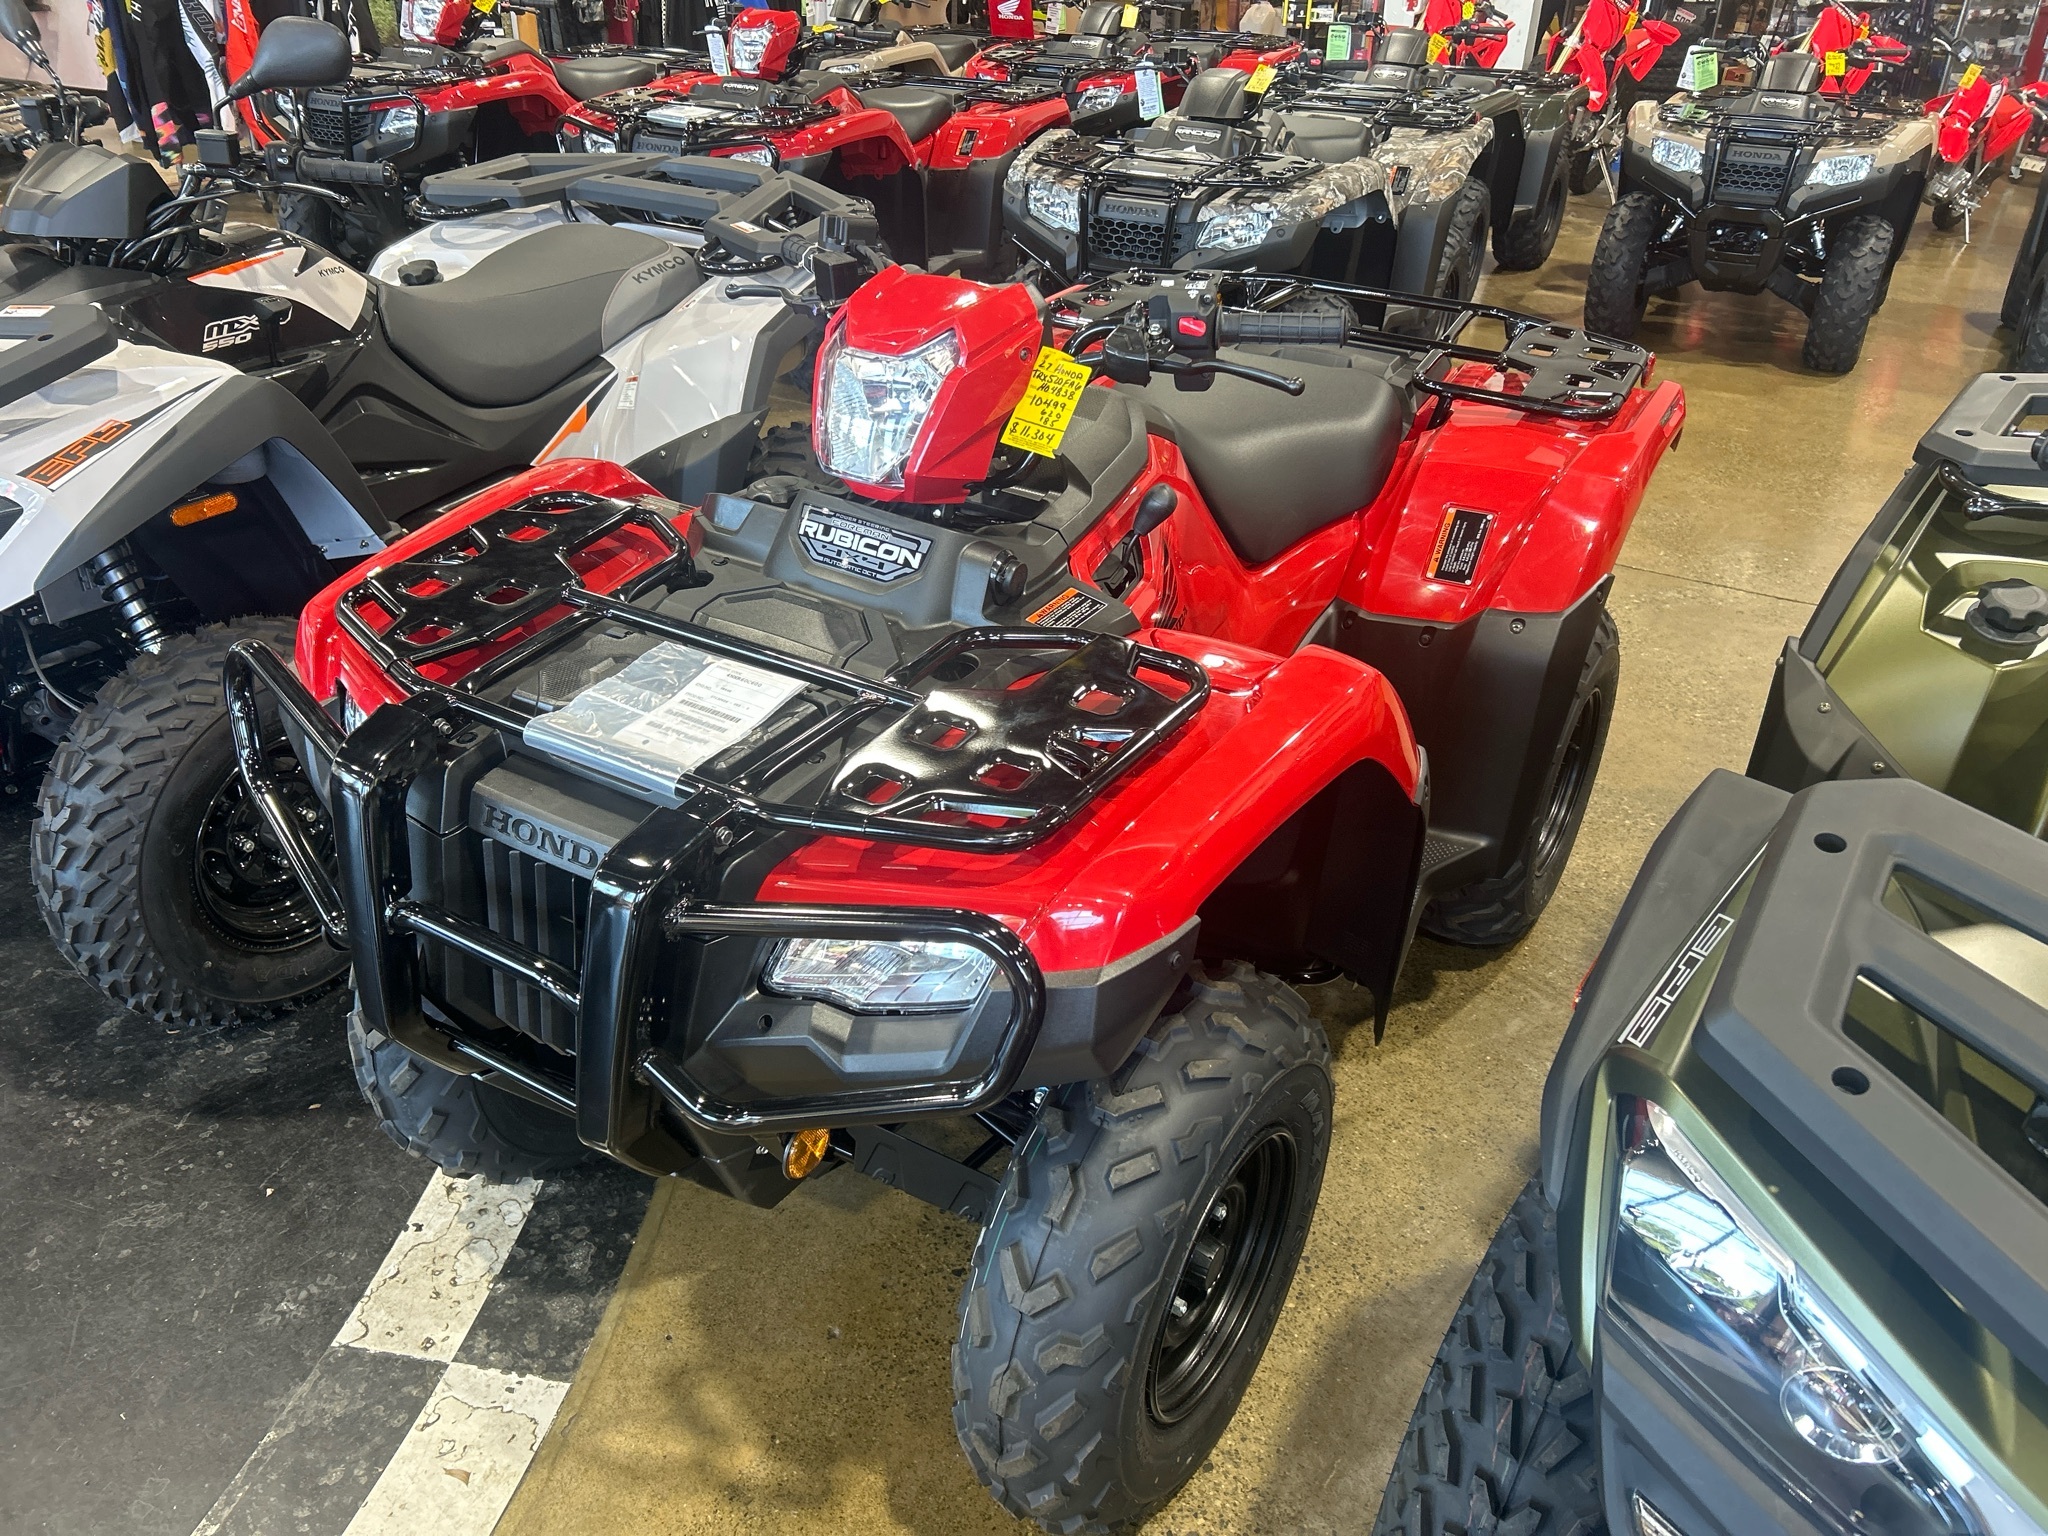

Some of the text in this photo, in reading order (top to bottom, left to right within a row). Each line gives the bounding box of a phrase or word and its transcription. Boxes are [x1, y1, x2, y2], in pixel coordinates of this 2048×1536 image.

[722, 83, 759, 93] FOREMAN
[1175, 129, 1221, 139] RANCHER
[636, 141, 679, 154] HONDA
[1732, 150, 1782, 161] HONDA
[1104, 203, 1160, 218] HONDA
[318, 265, 345, 278] KYMCO
[632, 256, 686, 284] KYMCO
[202, 332, 252, 353] 550
[1030, 394, 1067, 412] 10499
[1039, 417, 1060, 427] 185
[1040, 408, 1062, 420] 620
[831, 518, 891, 541] FOREMAN
[835, 513, 890, 532] POWER STEERING
[798, 519, 922, 569] RUBICON
[1436, 522, 1451, 556] WARNING
[1041, 594, 1070, 615] WARNING
[481, 803, 608, 871] HOND
